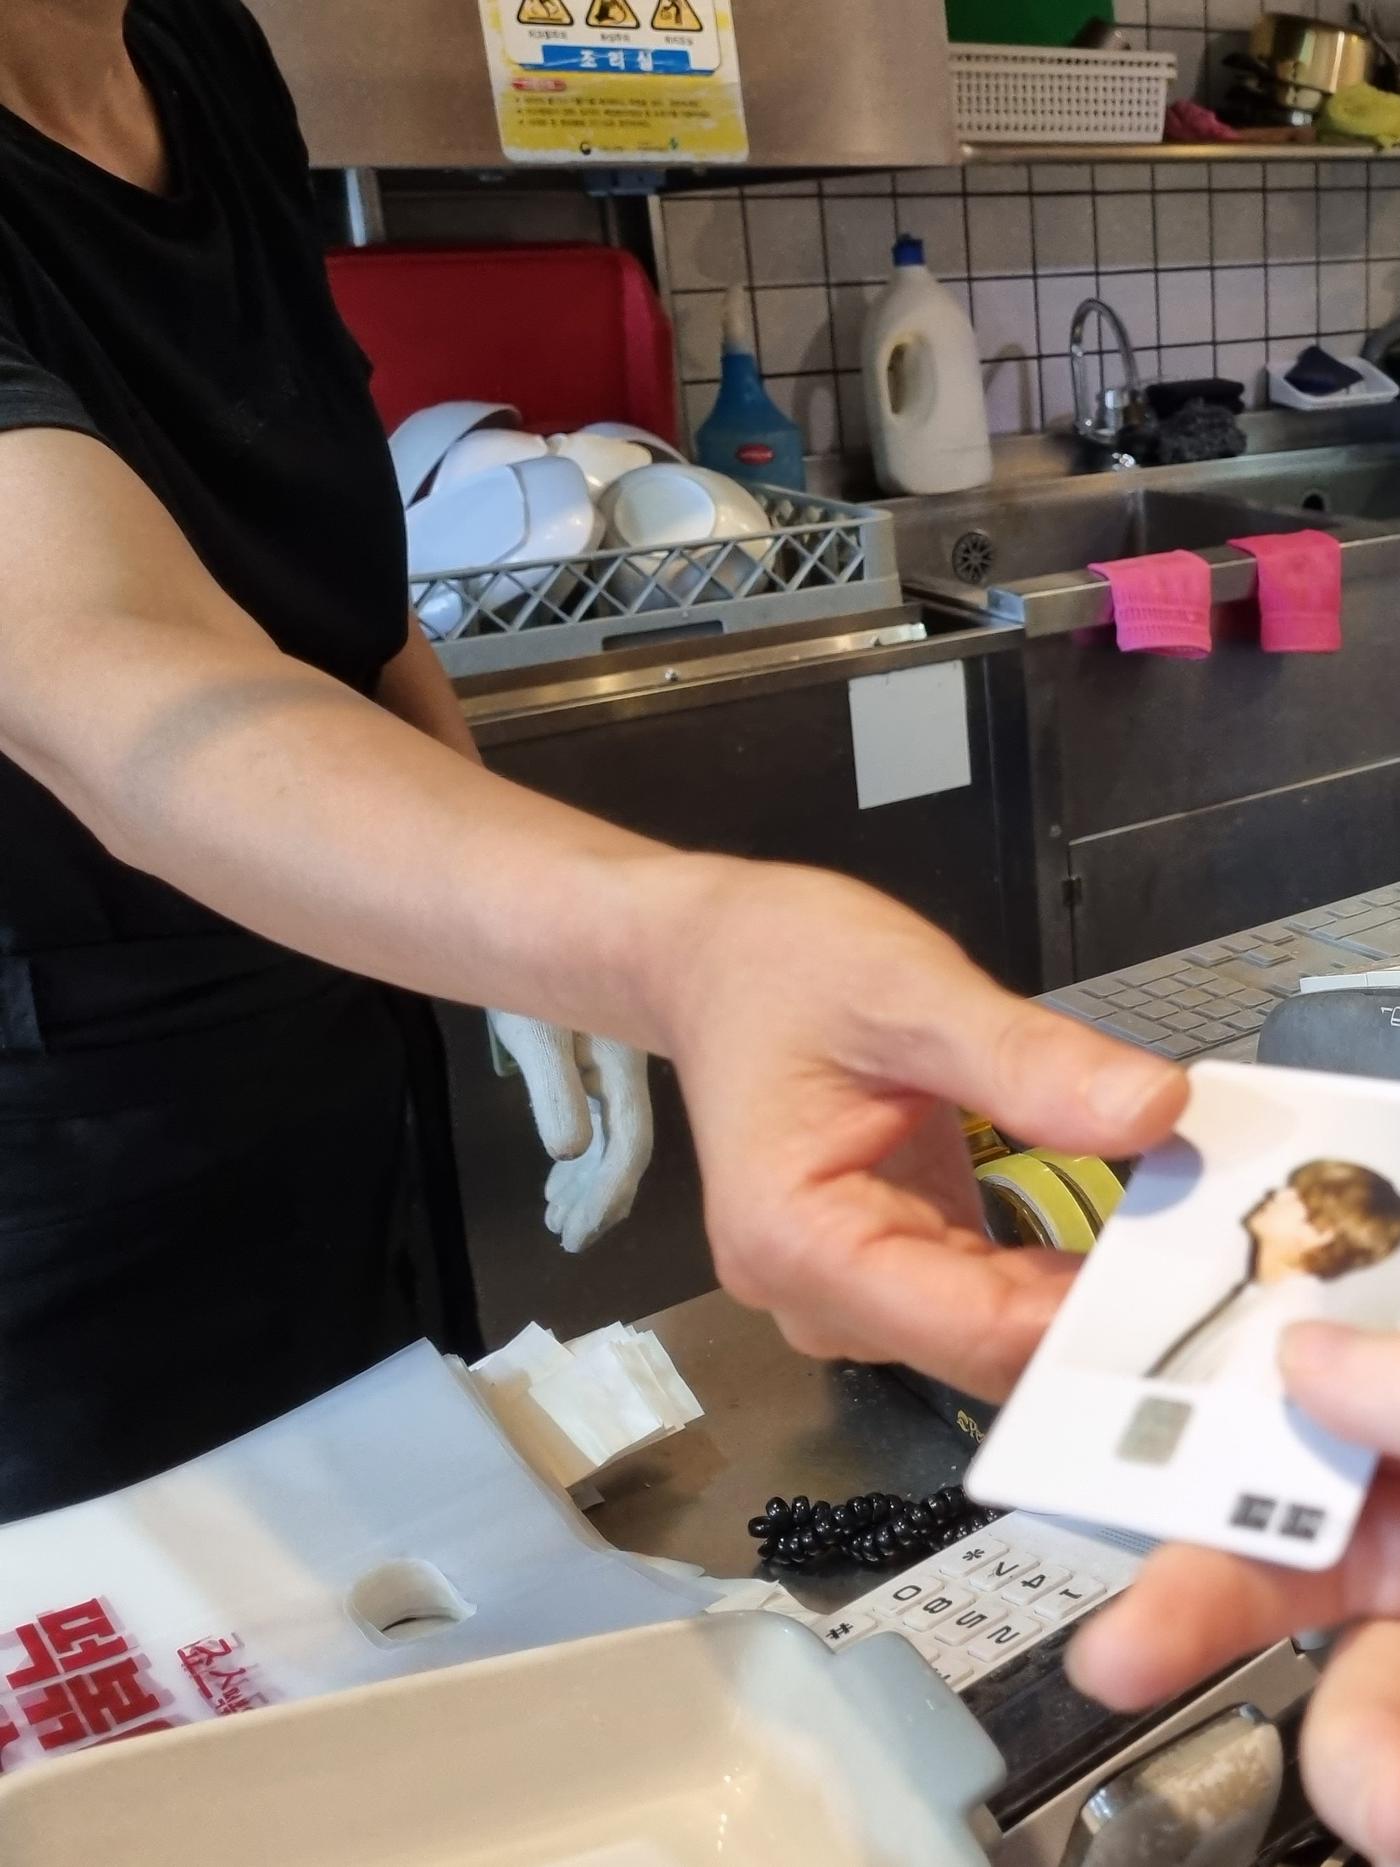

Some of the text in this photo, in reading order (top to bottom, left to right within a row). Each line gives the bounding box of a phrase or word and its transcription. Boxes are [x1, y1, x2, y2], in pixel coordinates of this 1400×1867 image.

[892, 1583, 923, 1603] 0
[956, 1574, 1047, 1628] 4 5
[922, 1597, 954, 1613] 8
[987, 1624, 1020, 1646] 2
[6, 1598, 172, 1752] 떡볶
